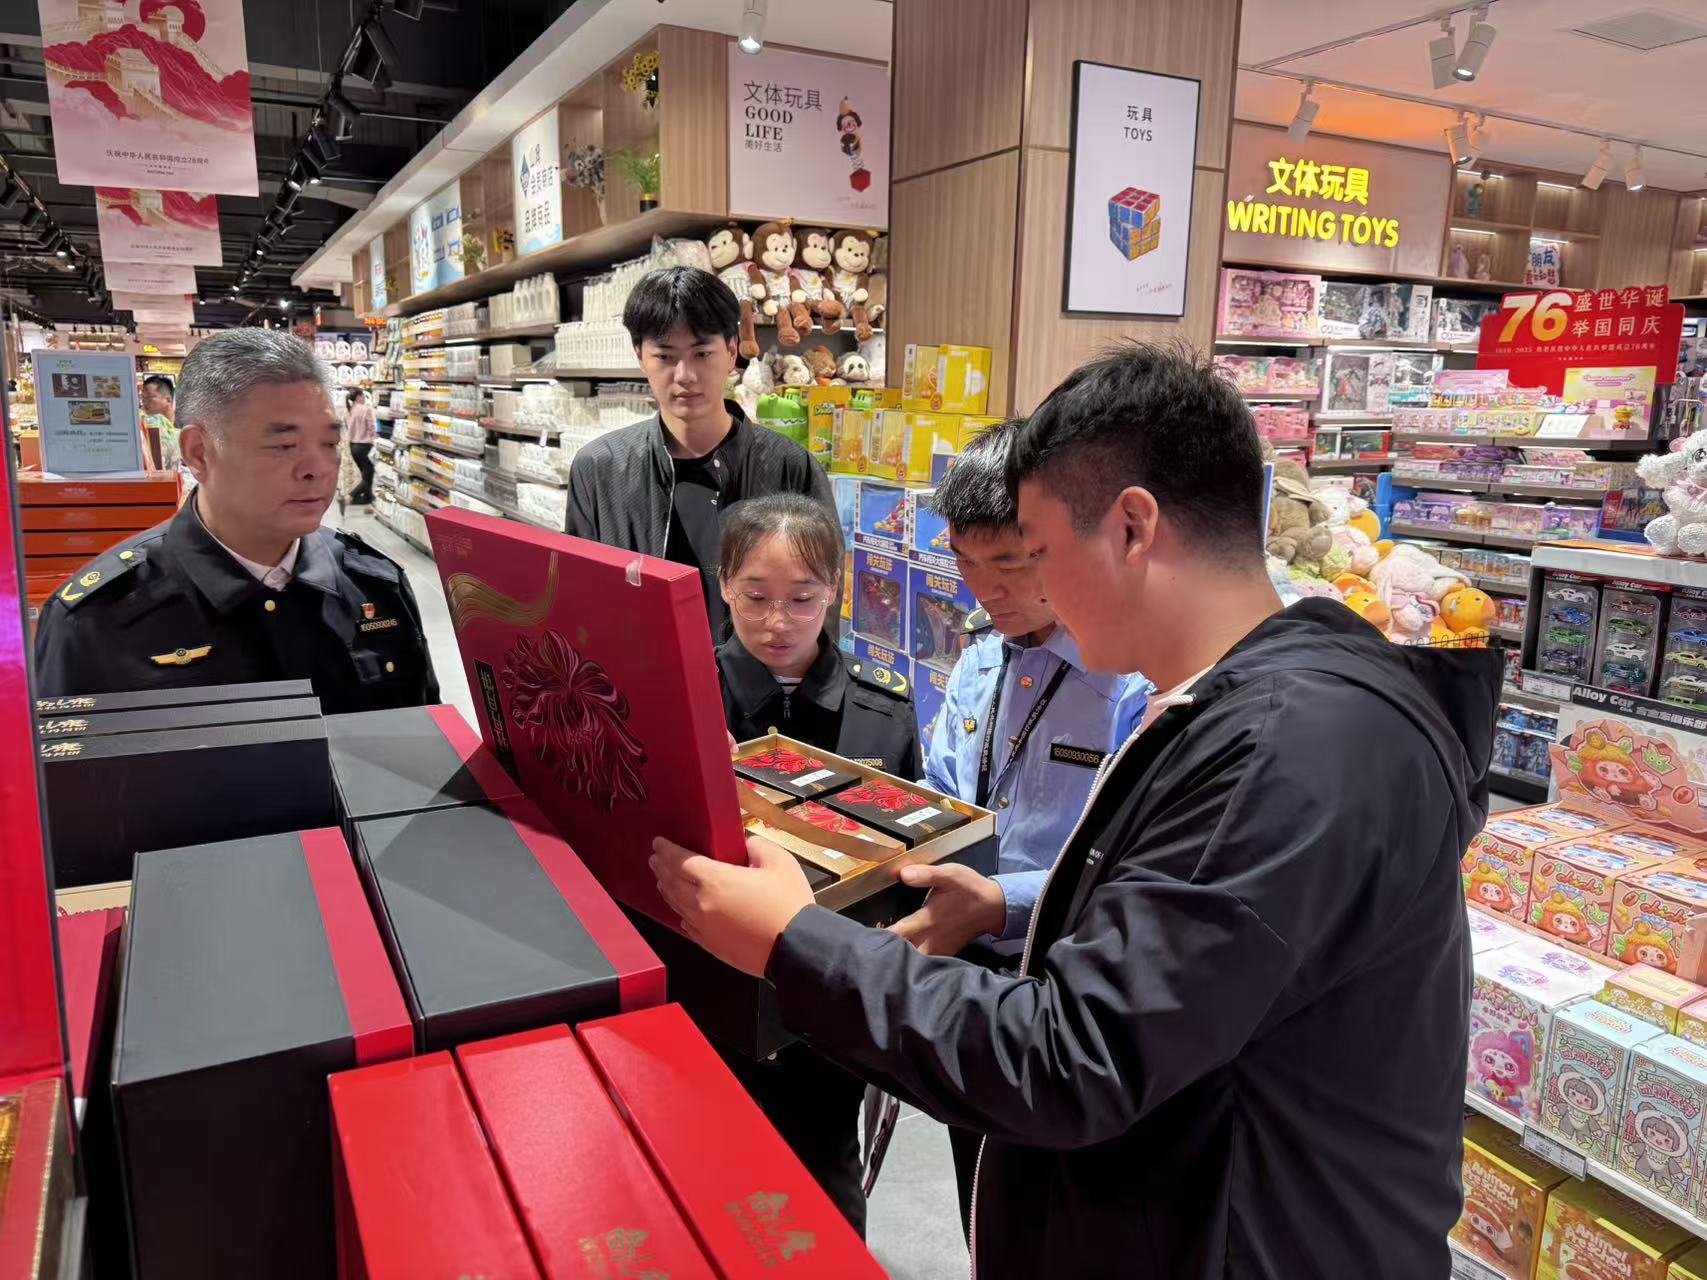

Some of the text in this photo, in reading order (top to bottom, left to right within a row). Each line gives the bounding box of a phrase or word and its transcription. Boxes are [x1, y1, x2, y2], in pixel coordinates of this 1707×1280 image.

[743, 80, 823, 112] 文体玩具
[745, 105, 793, 124] GOOD
[1126, 105, 1152, 122] 玩具
[745, 123, 783, 141] LIFE
[1123, 126, 1153, 142] TOYS
[744, 139, 783, 153] 美好生活
[1265, 156, 1370, 206] 文体玩具
[1227, 200, 1400, 248] WRITING TOYS
[1574, 288, 1666, 313] 盛世华诞
[1498, 292, 1573, 342] 76
[1571, 316, 1662, 338] 举国同庆
[926, 573, 958, 595] 闯关玩法
[929, 670, 949, 688] 闯关
[1572, 686, 1608, 703] Alloy
[1610, 695, 1634, 708] Car
[1471, 1161, 1516, 1196] Animal
[1575, 1223, 1628, 1263] Animal
